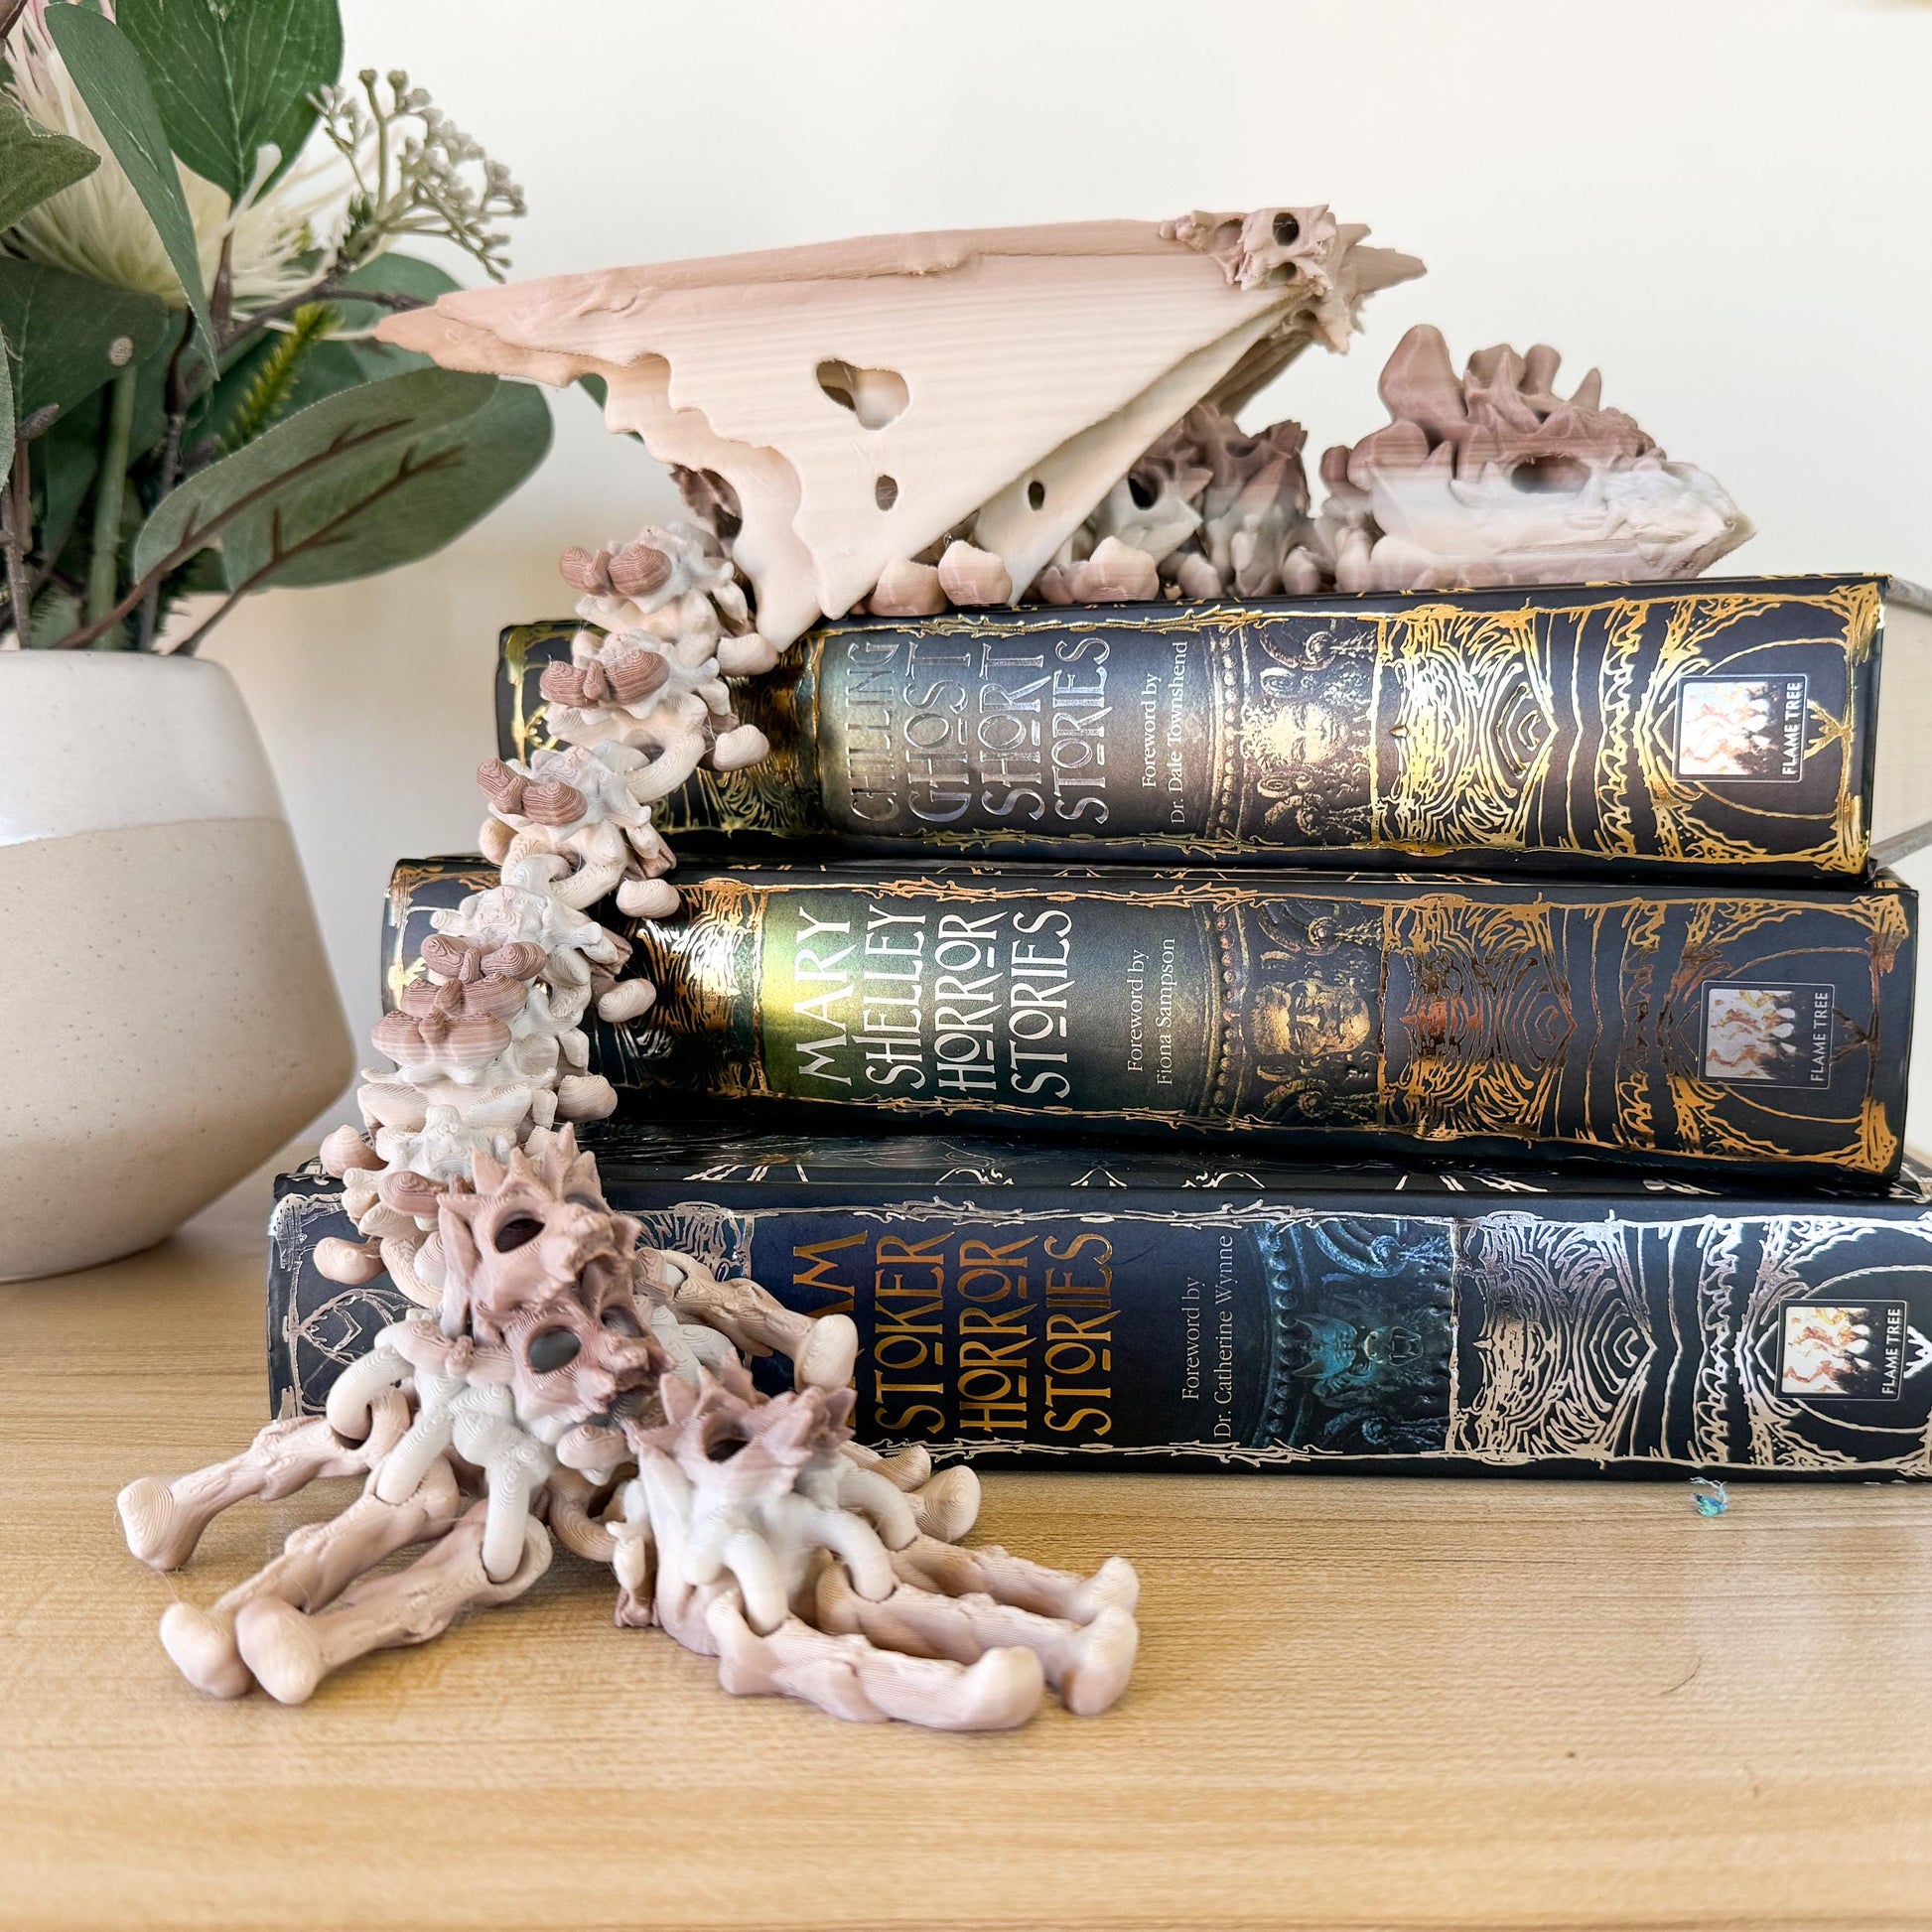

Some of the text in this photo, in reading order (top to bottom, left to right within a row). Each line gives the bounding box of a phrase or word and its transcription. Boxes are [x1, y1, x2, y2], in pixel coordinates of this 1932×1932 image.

[845, 641, 899, 822] CHILLING
[903, 641, 973, 823] GHOST
[977, 643, 1051, 821] SHORT
[1050, 636, 1113, 825] STORIES
[1142, 673, 1163, 789] Foreword by
[1167, 640, 1187, 825] Dr. Dale Townshend
[1782, 682, 1802, 775] FLAME TREE
[795, 905, 857, 1086] MARY
[853, 903, 927, 1090] SHELLEY
[933, 909, 1009, 1092] HORROR
[1008, 909, 1076, 1099] STORIES
[1127, 949, 1150, 1072] Foreword by
[1157, 937, 1176, 1086] Fiona Sampson
[1811, 993, 1829, 1081] FLAME TREE
[874, 1230, 956, 1435] STOKER
[957, 1234, 1039, 1433] HORROR
[1043, 1232, 1121, 1437] STORIES
[1181, 1276, 1205, 1401] Foreword by
[1213, 1234, 1237, 1439] Dr. Catherine Wynne
[1882, 1309, 1901, 1394] FLAME TREE
